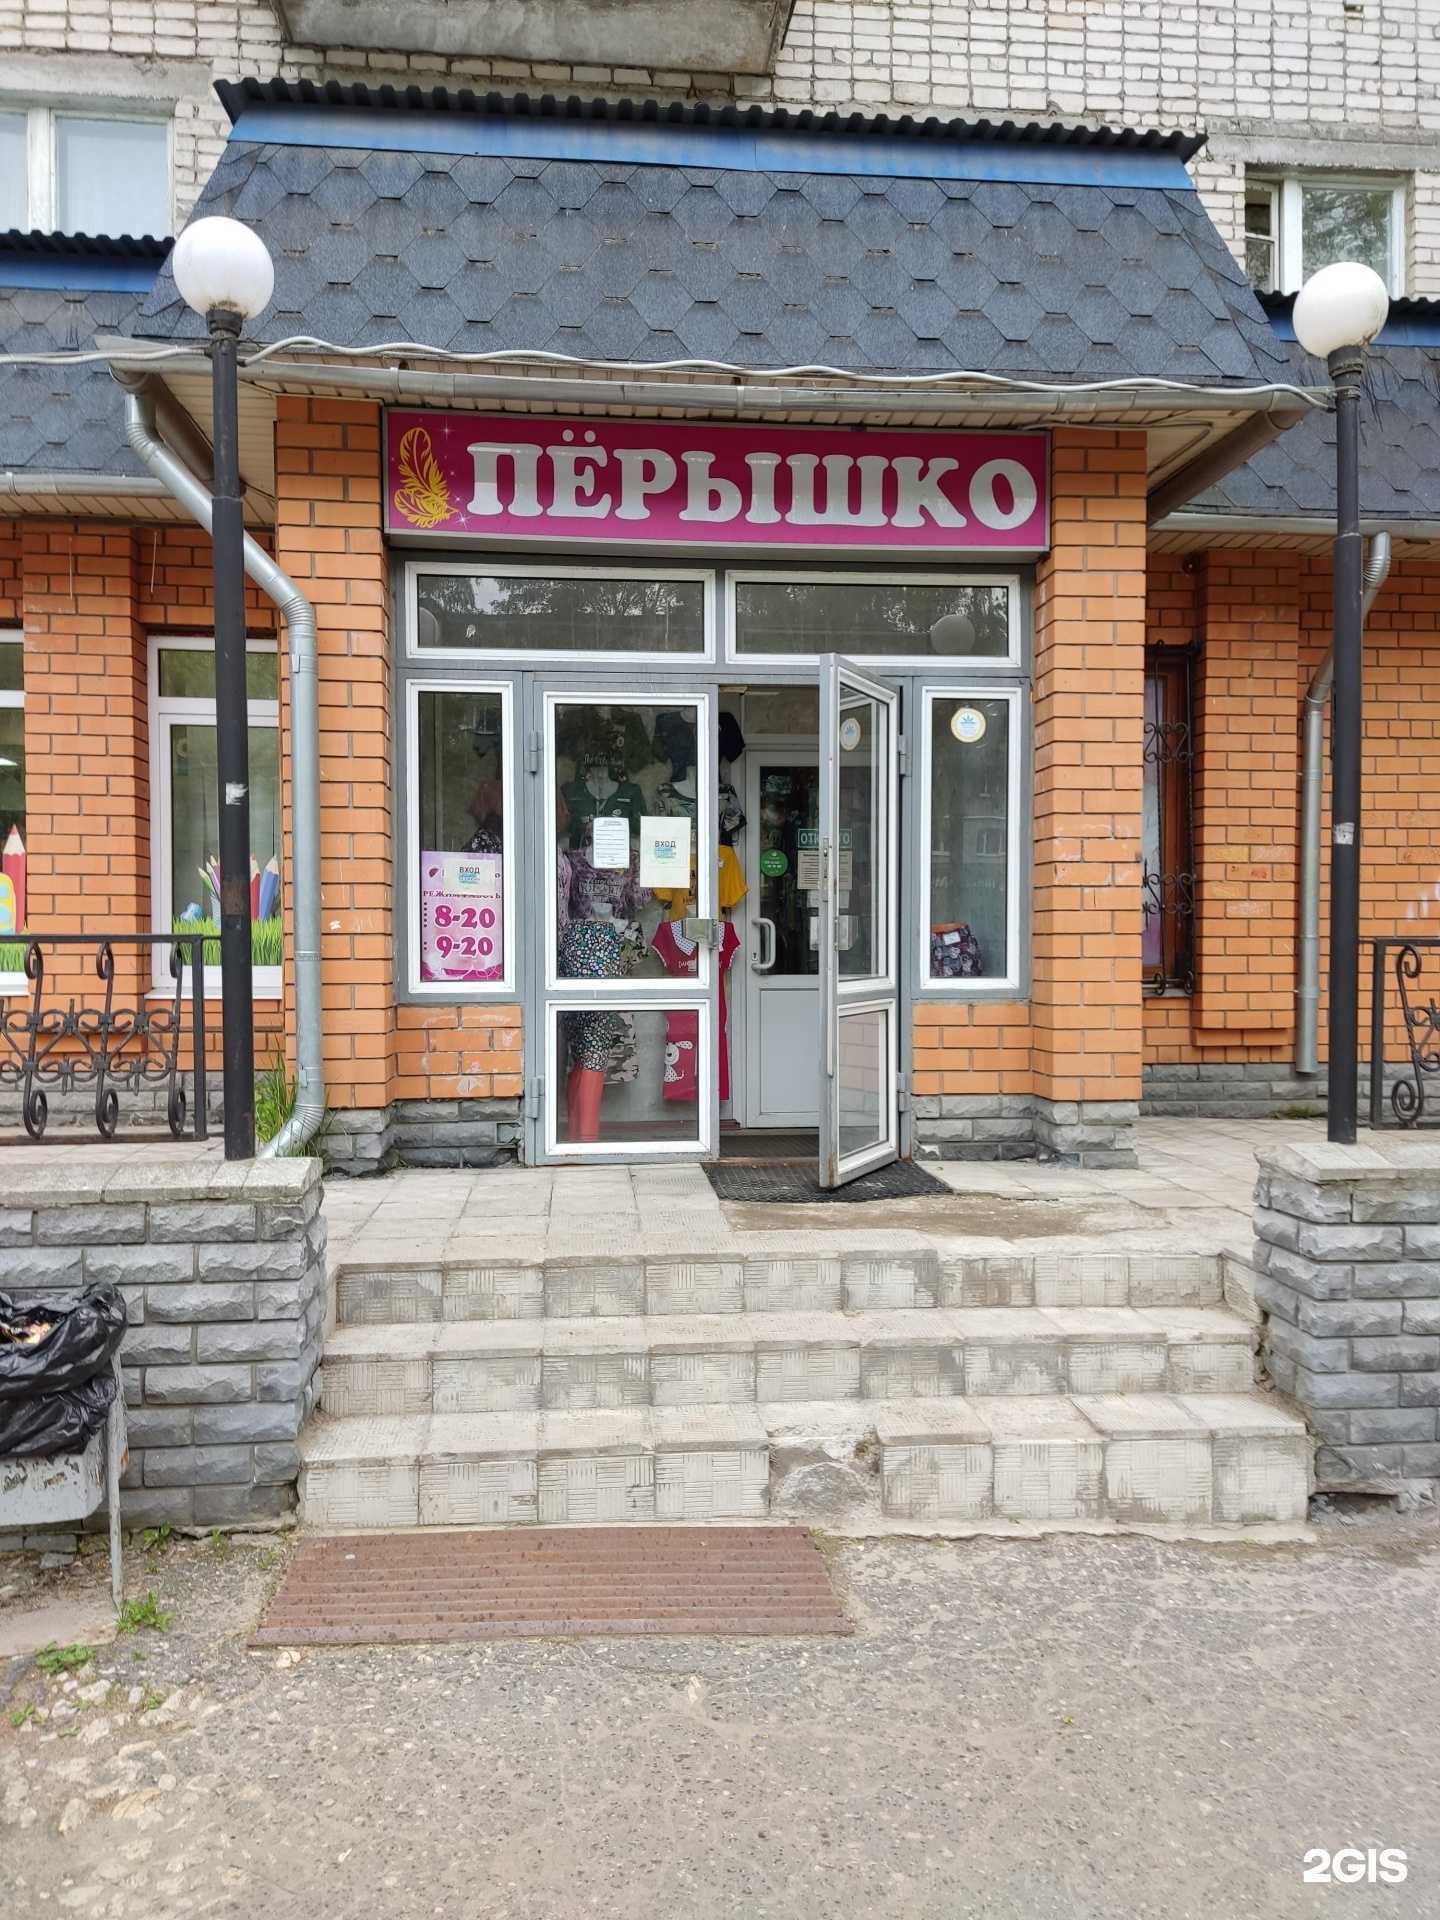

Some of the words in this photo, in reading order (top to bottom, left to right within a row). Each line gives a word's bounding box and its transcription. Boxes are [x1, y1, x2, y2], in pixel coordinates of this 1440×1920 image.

[466, 429, 1037, 530] ПЁРЫШКО
[655, 840, 676, 848] ВХОД
[459, 866, 480, 874] ВХОД
[434, 904, 496, 929] 8-20
[435, 935, 494, 959] 9-20
